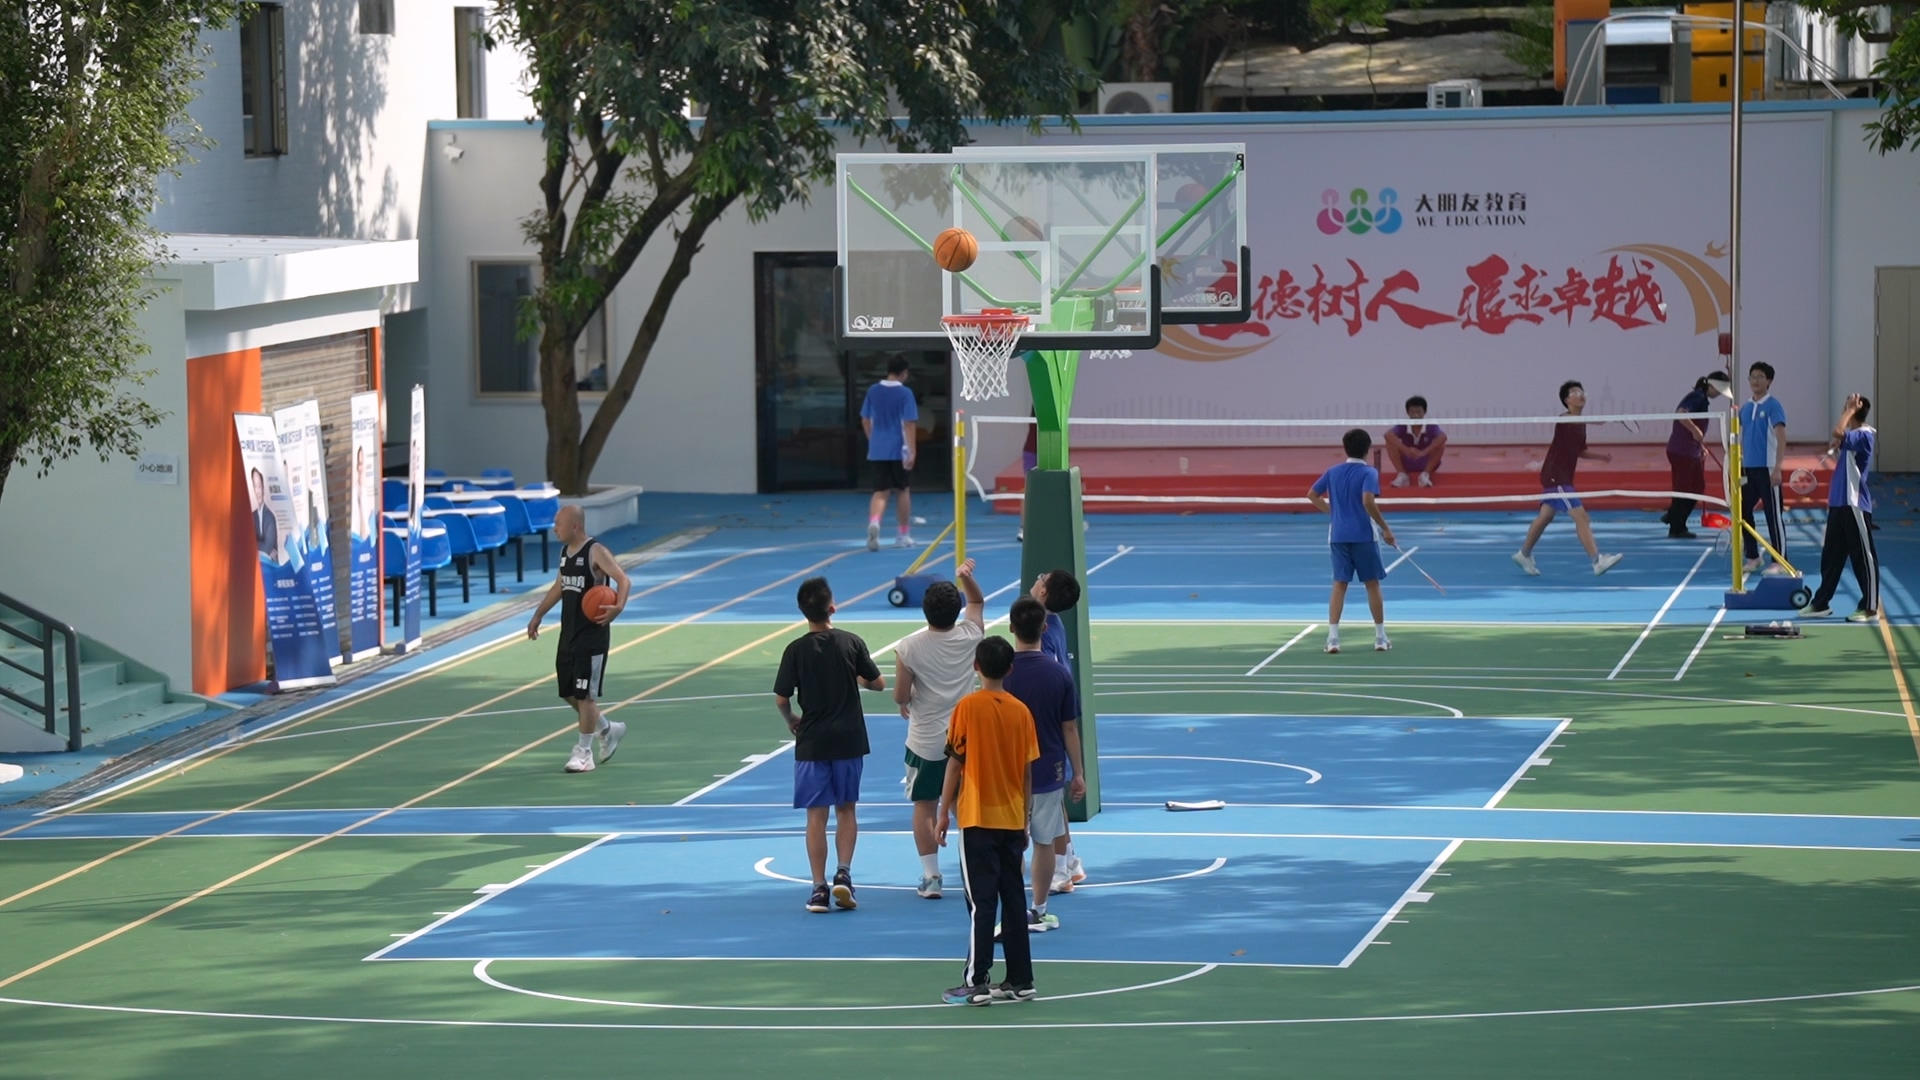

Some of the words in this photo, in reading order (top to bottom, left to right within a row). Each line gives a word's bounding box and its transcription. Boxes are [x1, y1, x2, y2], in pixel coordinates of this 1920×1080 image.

[1415, 192, 1527, 212] 大朋友教育
[1416, 215, 1435, 227] WE
[1446, 215, 1526, 227] EDUCATION
[1458, 254, 1667, 334] 追求卓越
[576, 678, 589, 690] 30
